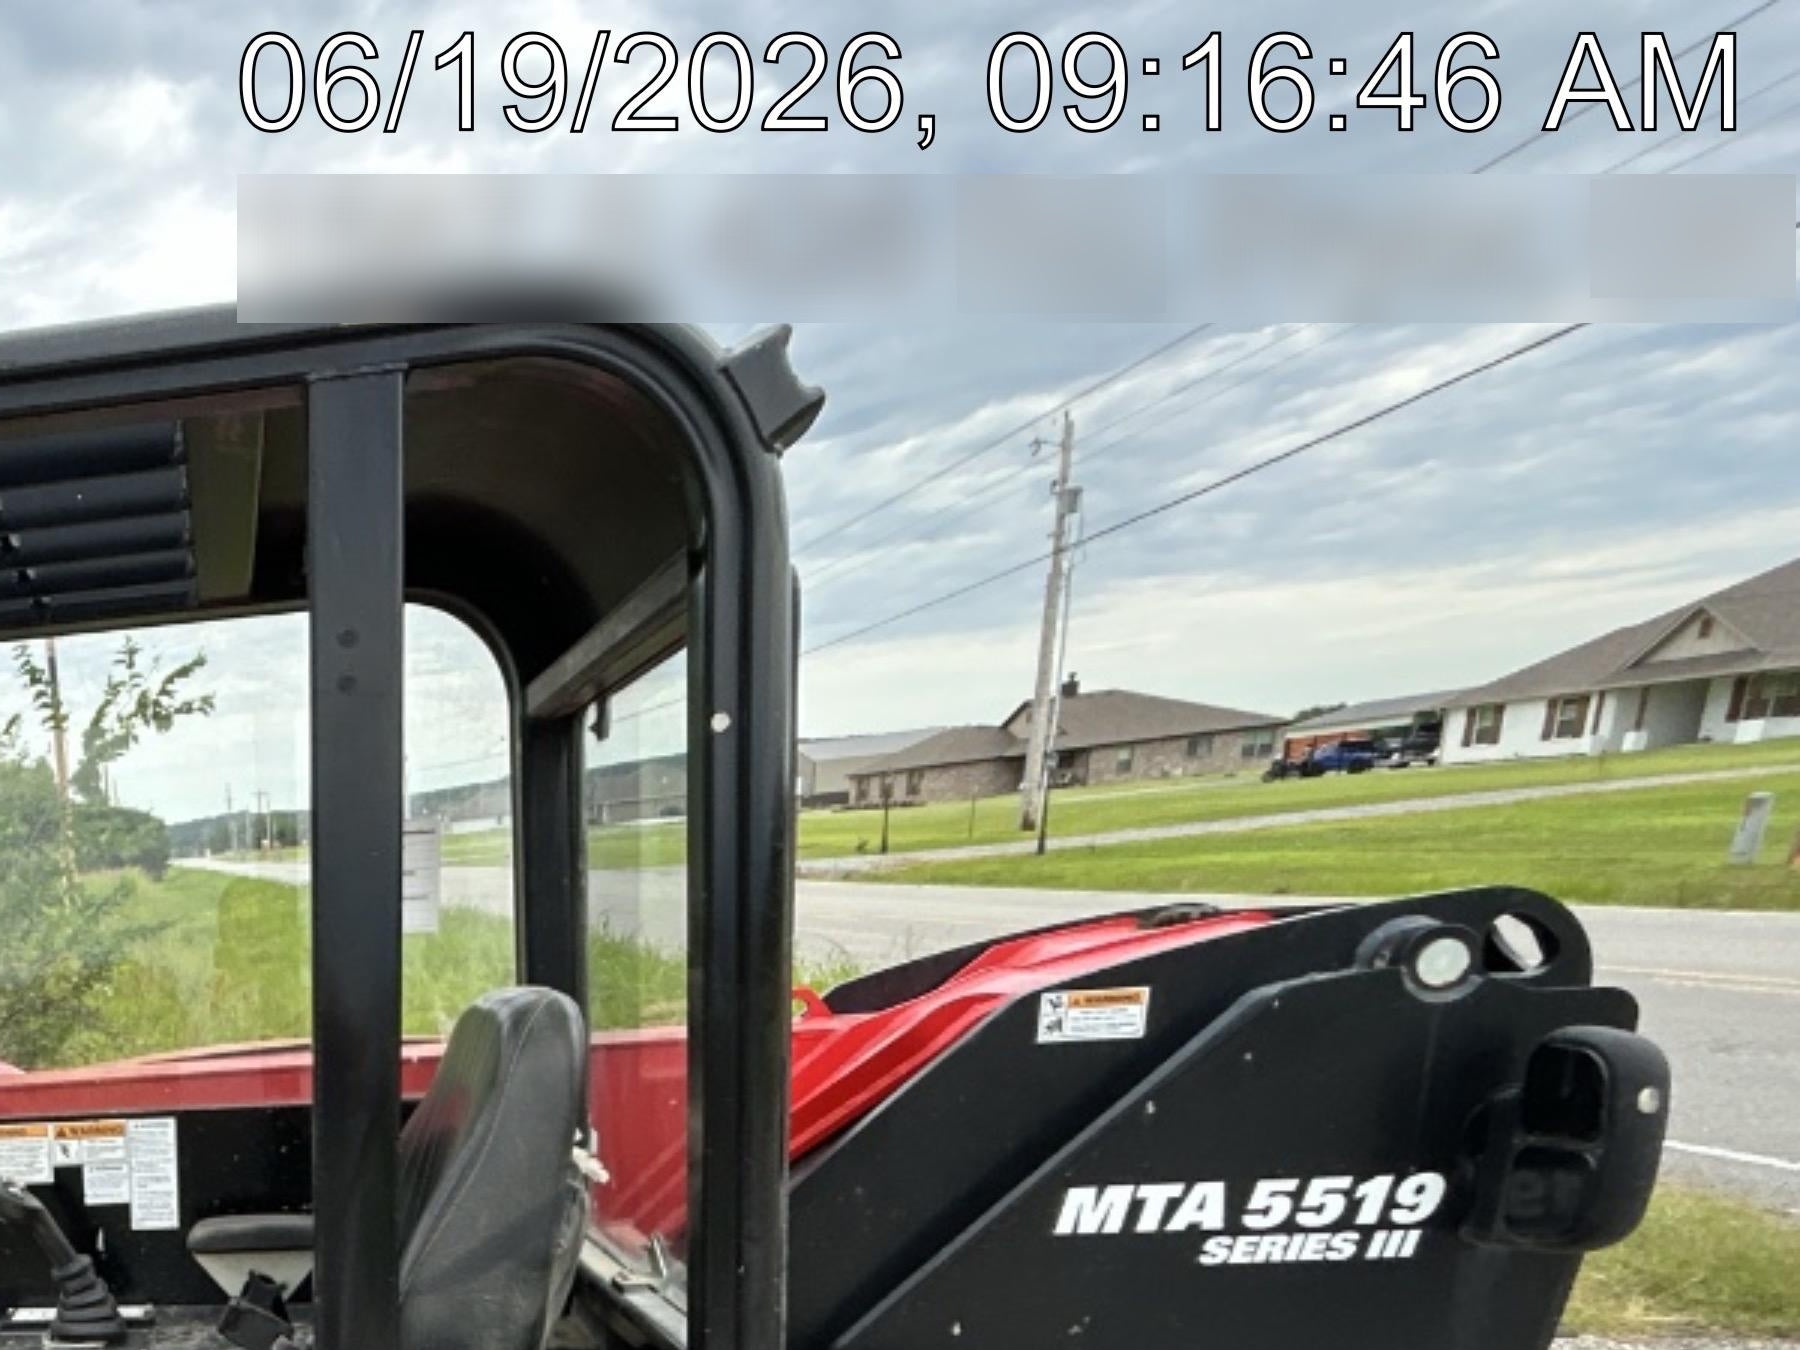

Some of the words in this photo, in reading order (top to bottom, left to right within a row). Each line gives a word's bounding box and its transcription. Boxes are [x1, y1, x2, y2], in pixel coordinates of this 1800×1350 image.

[1053, 1181, 1225, 1236] MTA
[1241, 1172, 1446, 1229] 5519
[1198, 1231, 1360, 1266] SERIES
[1364, 1229, 1423, 1260] III
